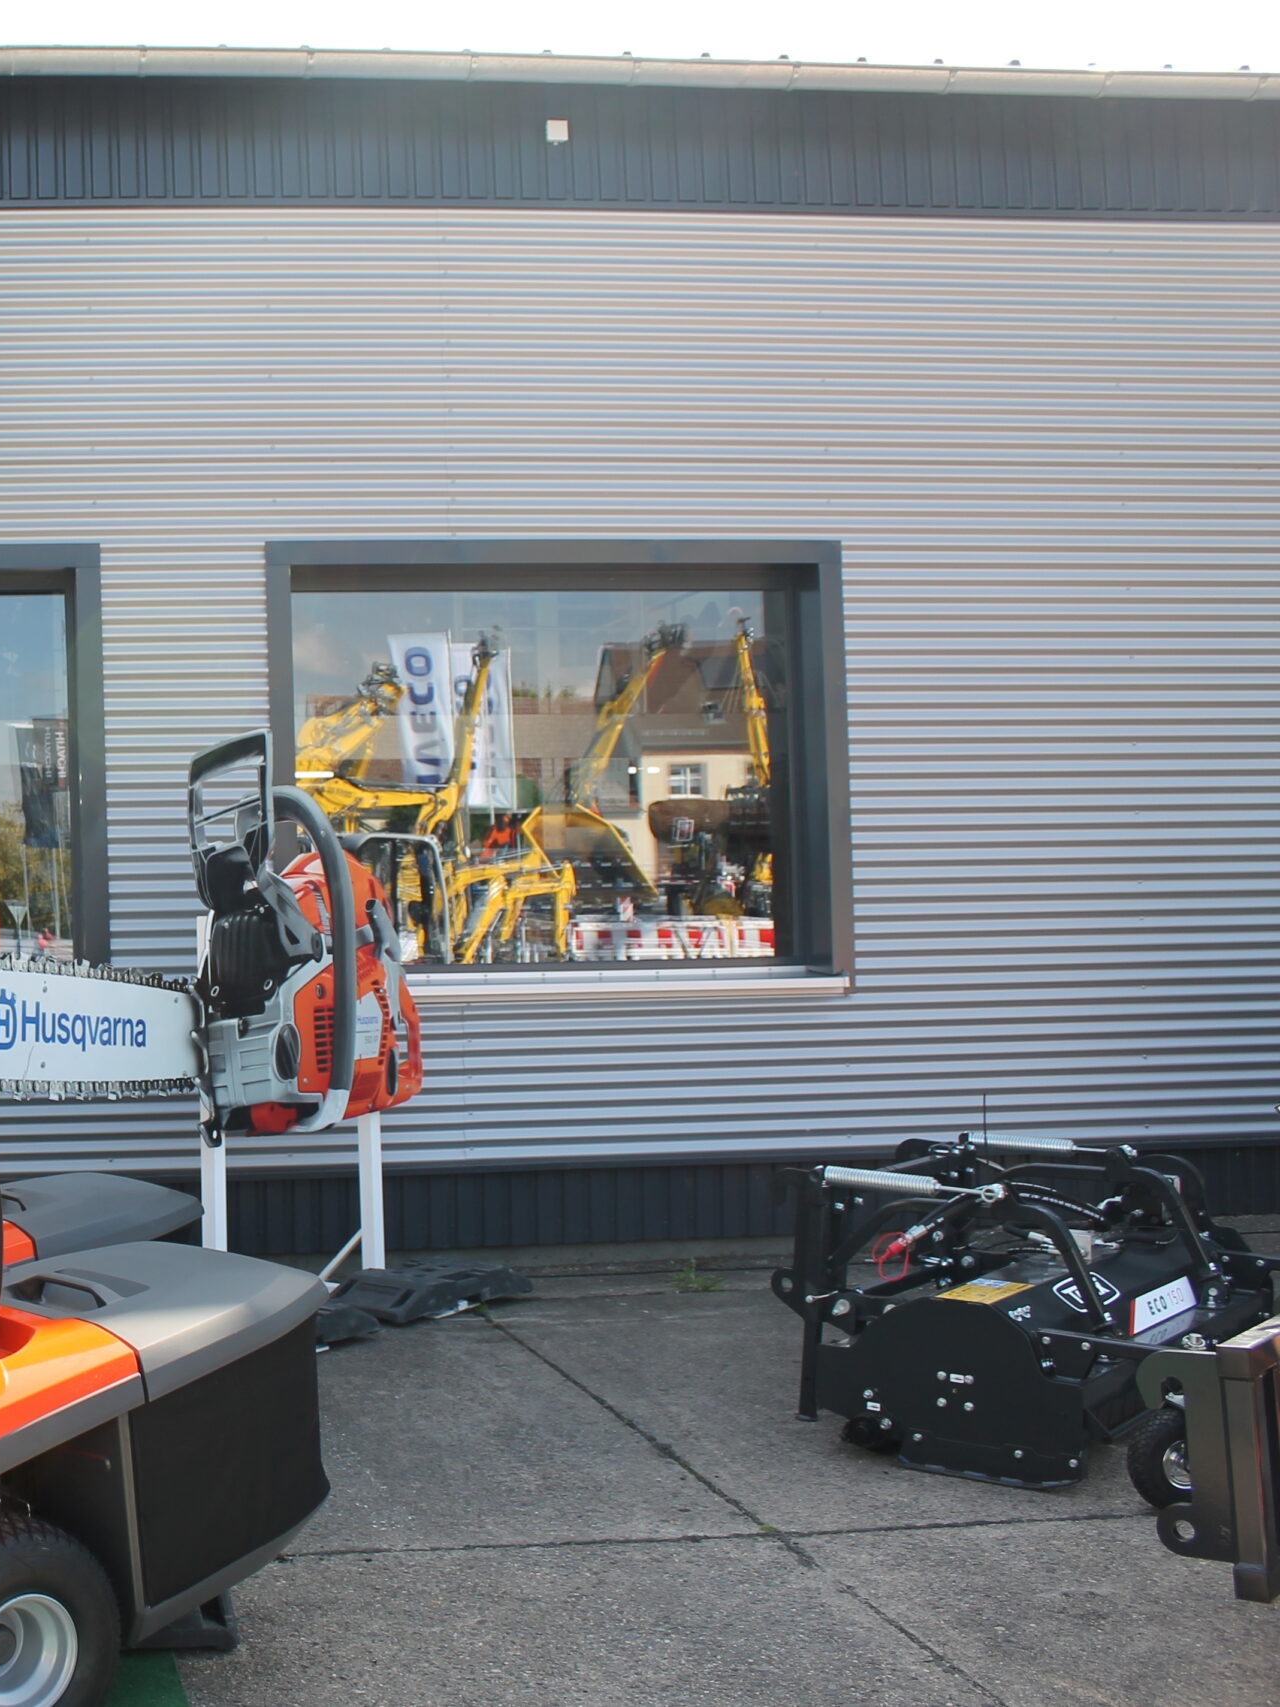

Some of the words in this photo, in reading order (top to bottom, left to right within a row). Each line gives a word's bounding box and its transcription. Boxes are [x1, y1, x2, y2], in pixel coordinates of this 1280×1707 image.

[21, 1000, 147, 1052] Husqvarna
[1146, 1296, 1169, 1316] ECO
[1167, 1287, 1185, 1305] 150
